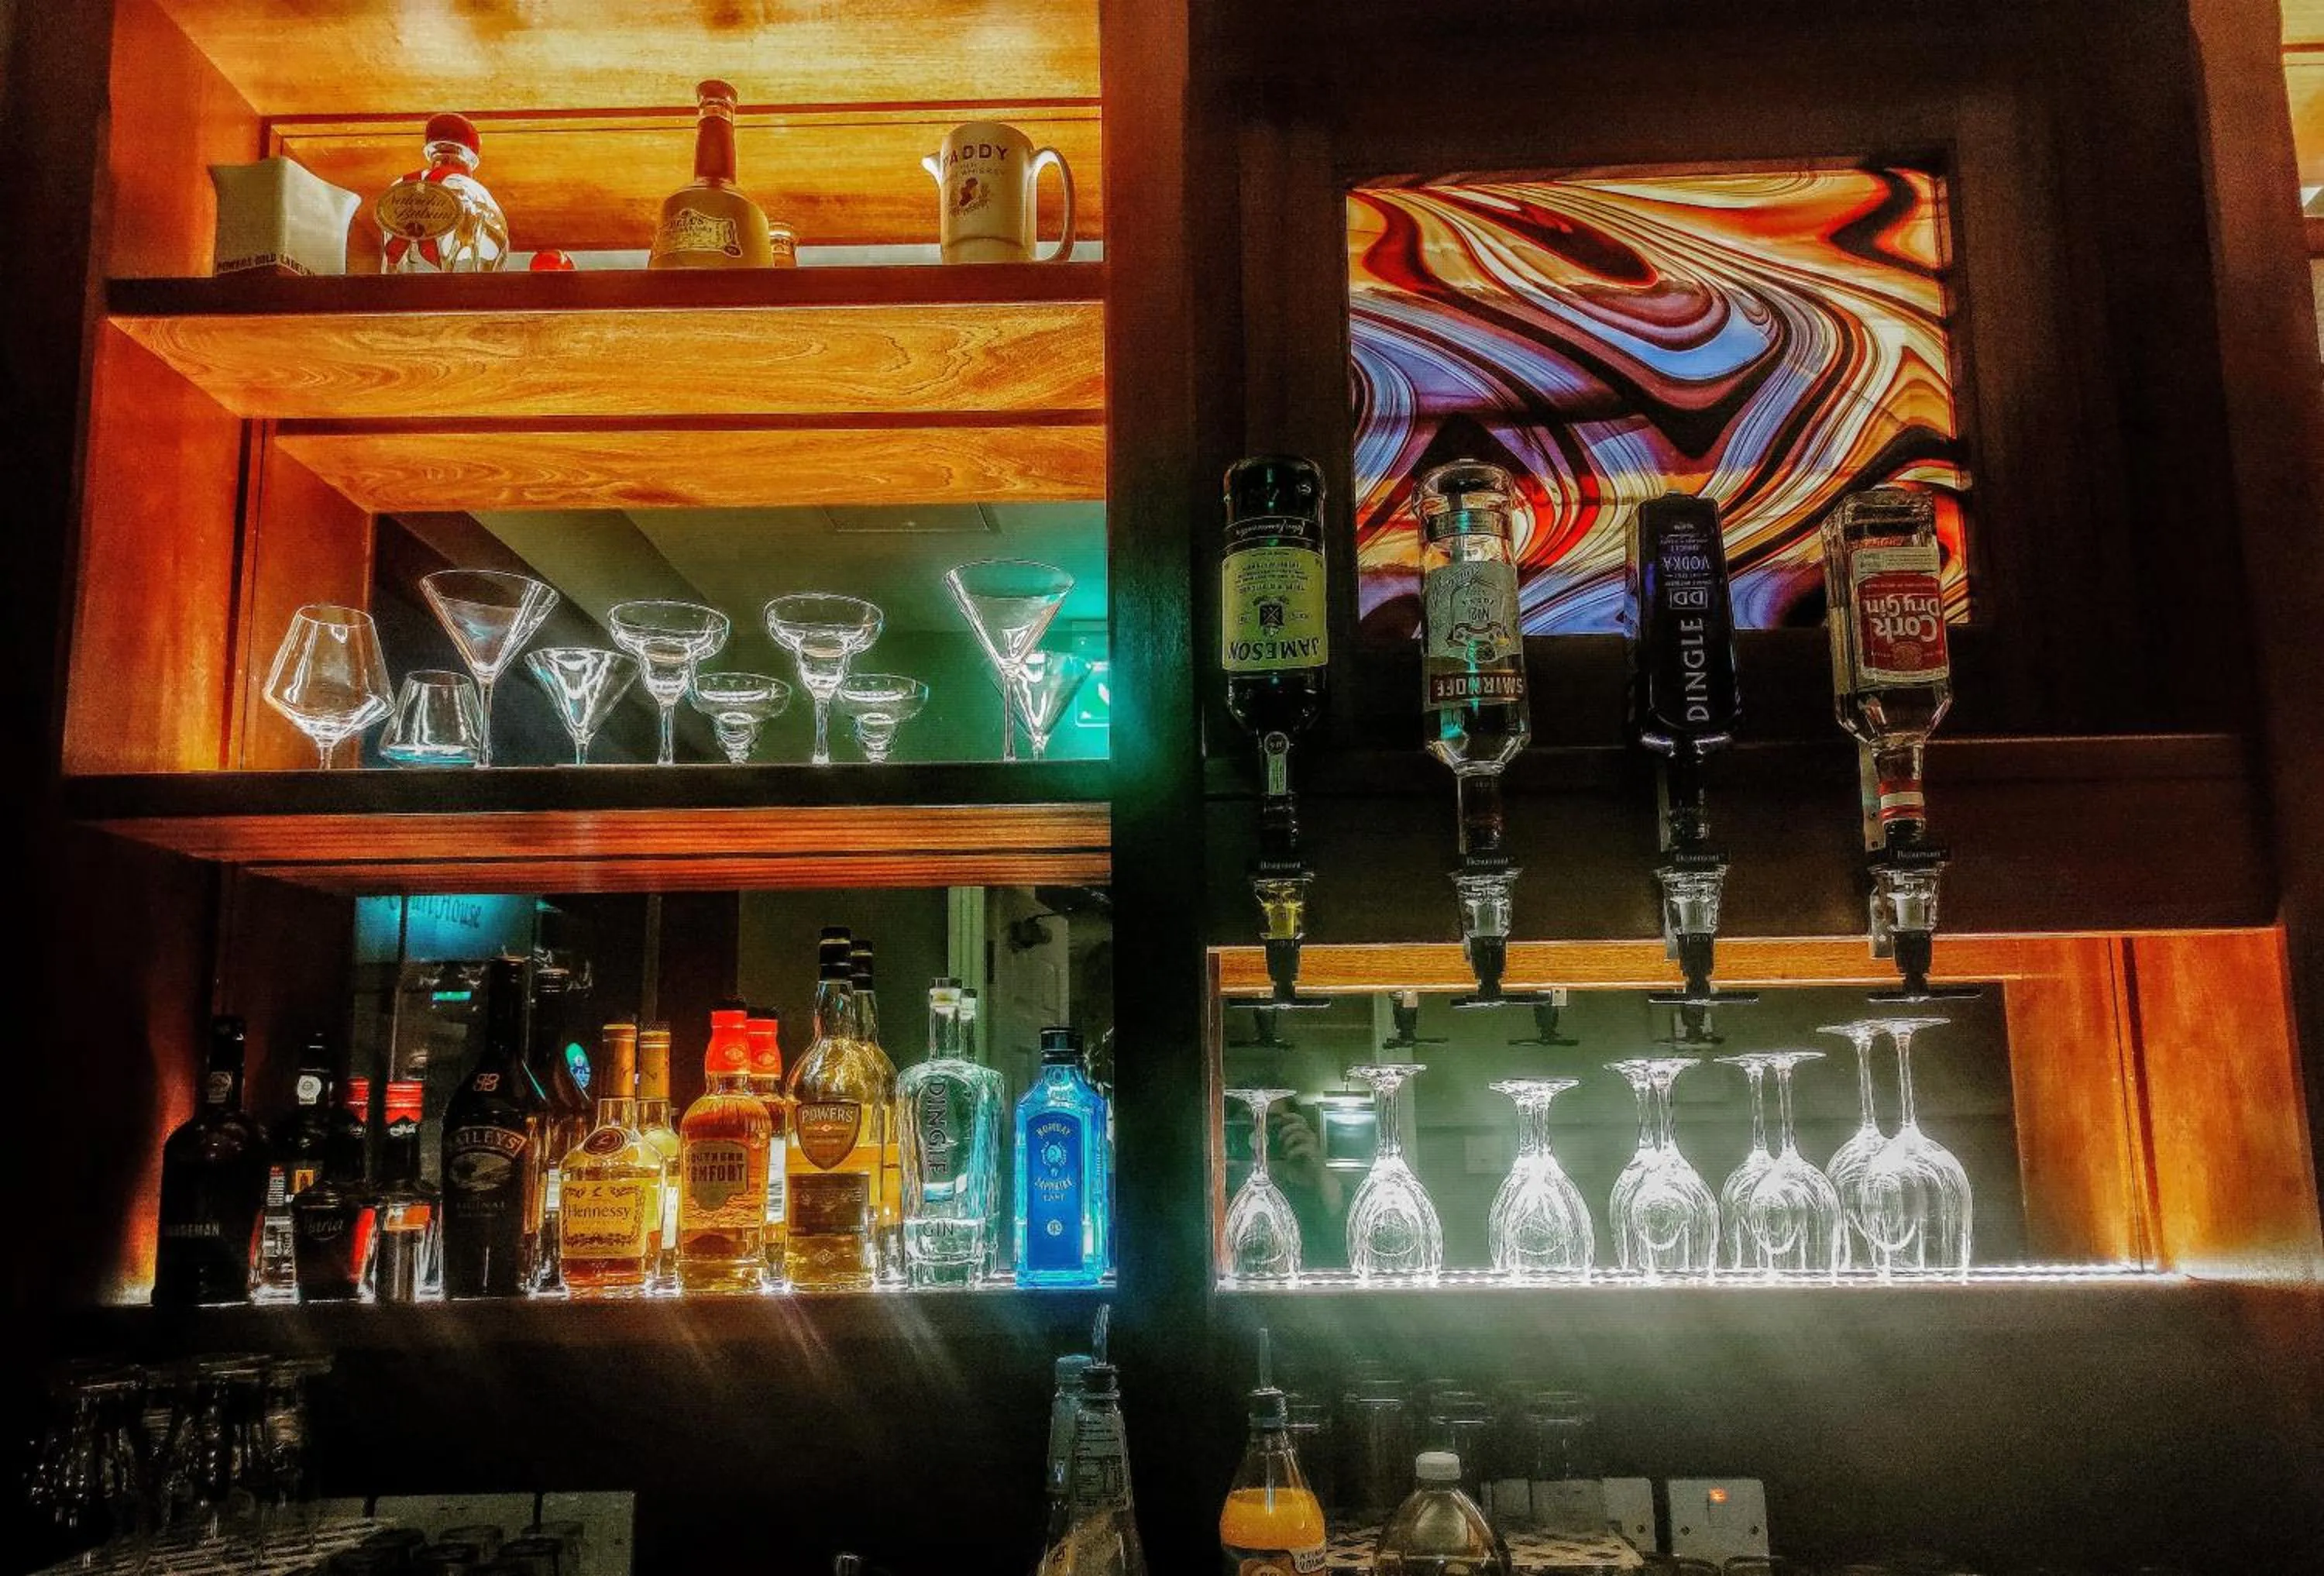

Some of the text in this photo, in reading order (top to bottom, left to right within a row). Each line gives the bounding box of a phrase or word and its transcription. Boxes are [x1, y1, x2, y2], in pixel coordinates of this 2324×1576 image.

[1663, 554, 1710, 572] VODKA
[1865, 594, 1941, 618] Dry Gin
[1871, 614, 1938, 643] Cork
[1228, 638, 1320, 662] JAMESON
[1681, 618, 1710, 722] DINGLE
[1437, 675, 1525, 697] SMIRNOFF
[802, 1106, 853, 1123] POWERS
[928, 1082, 947, 1175] DINGLE
[453, 1130, 520, 1151] AILEYS
[568, 1203, 631, 1220] Hennessy
[923, 1221, 954, 1237] GIN
